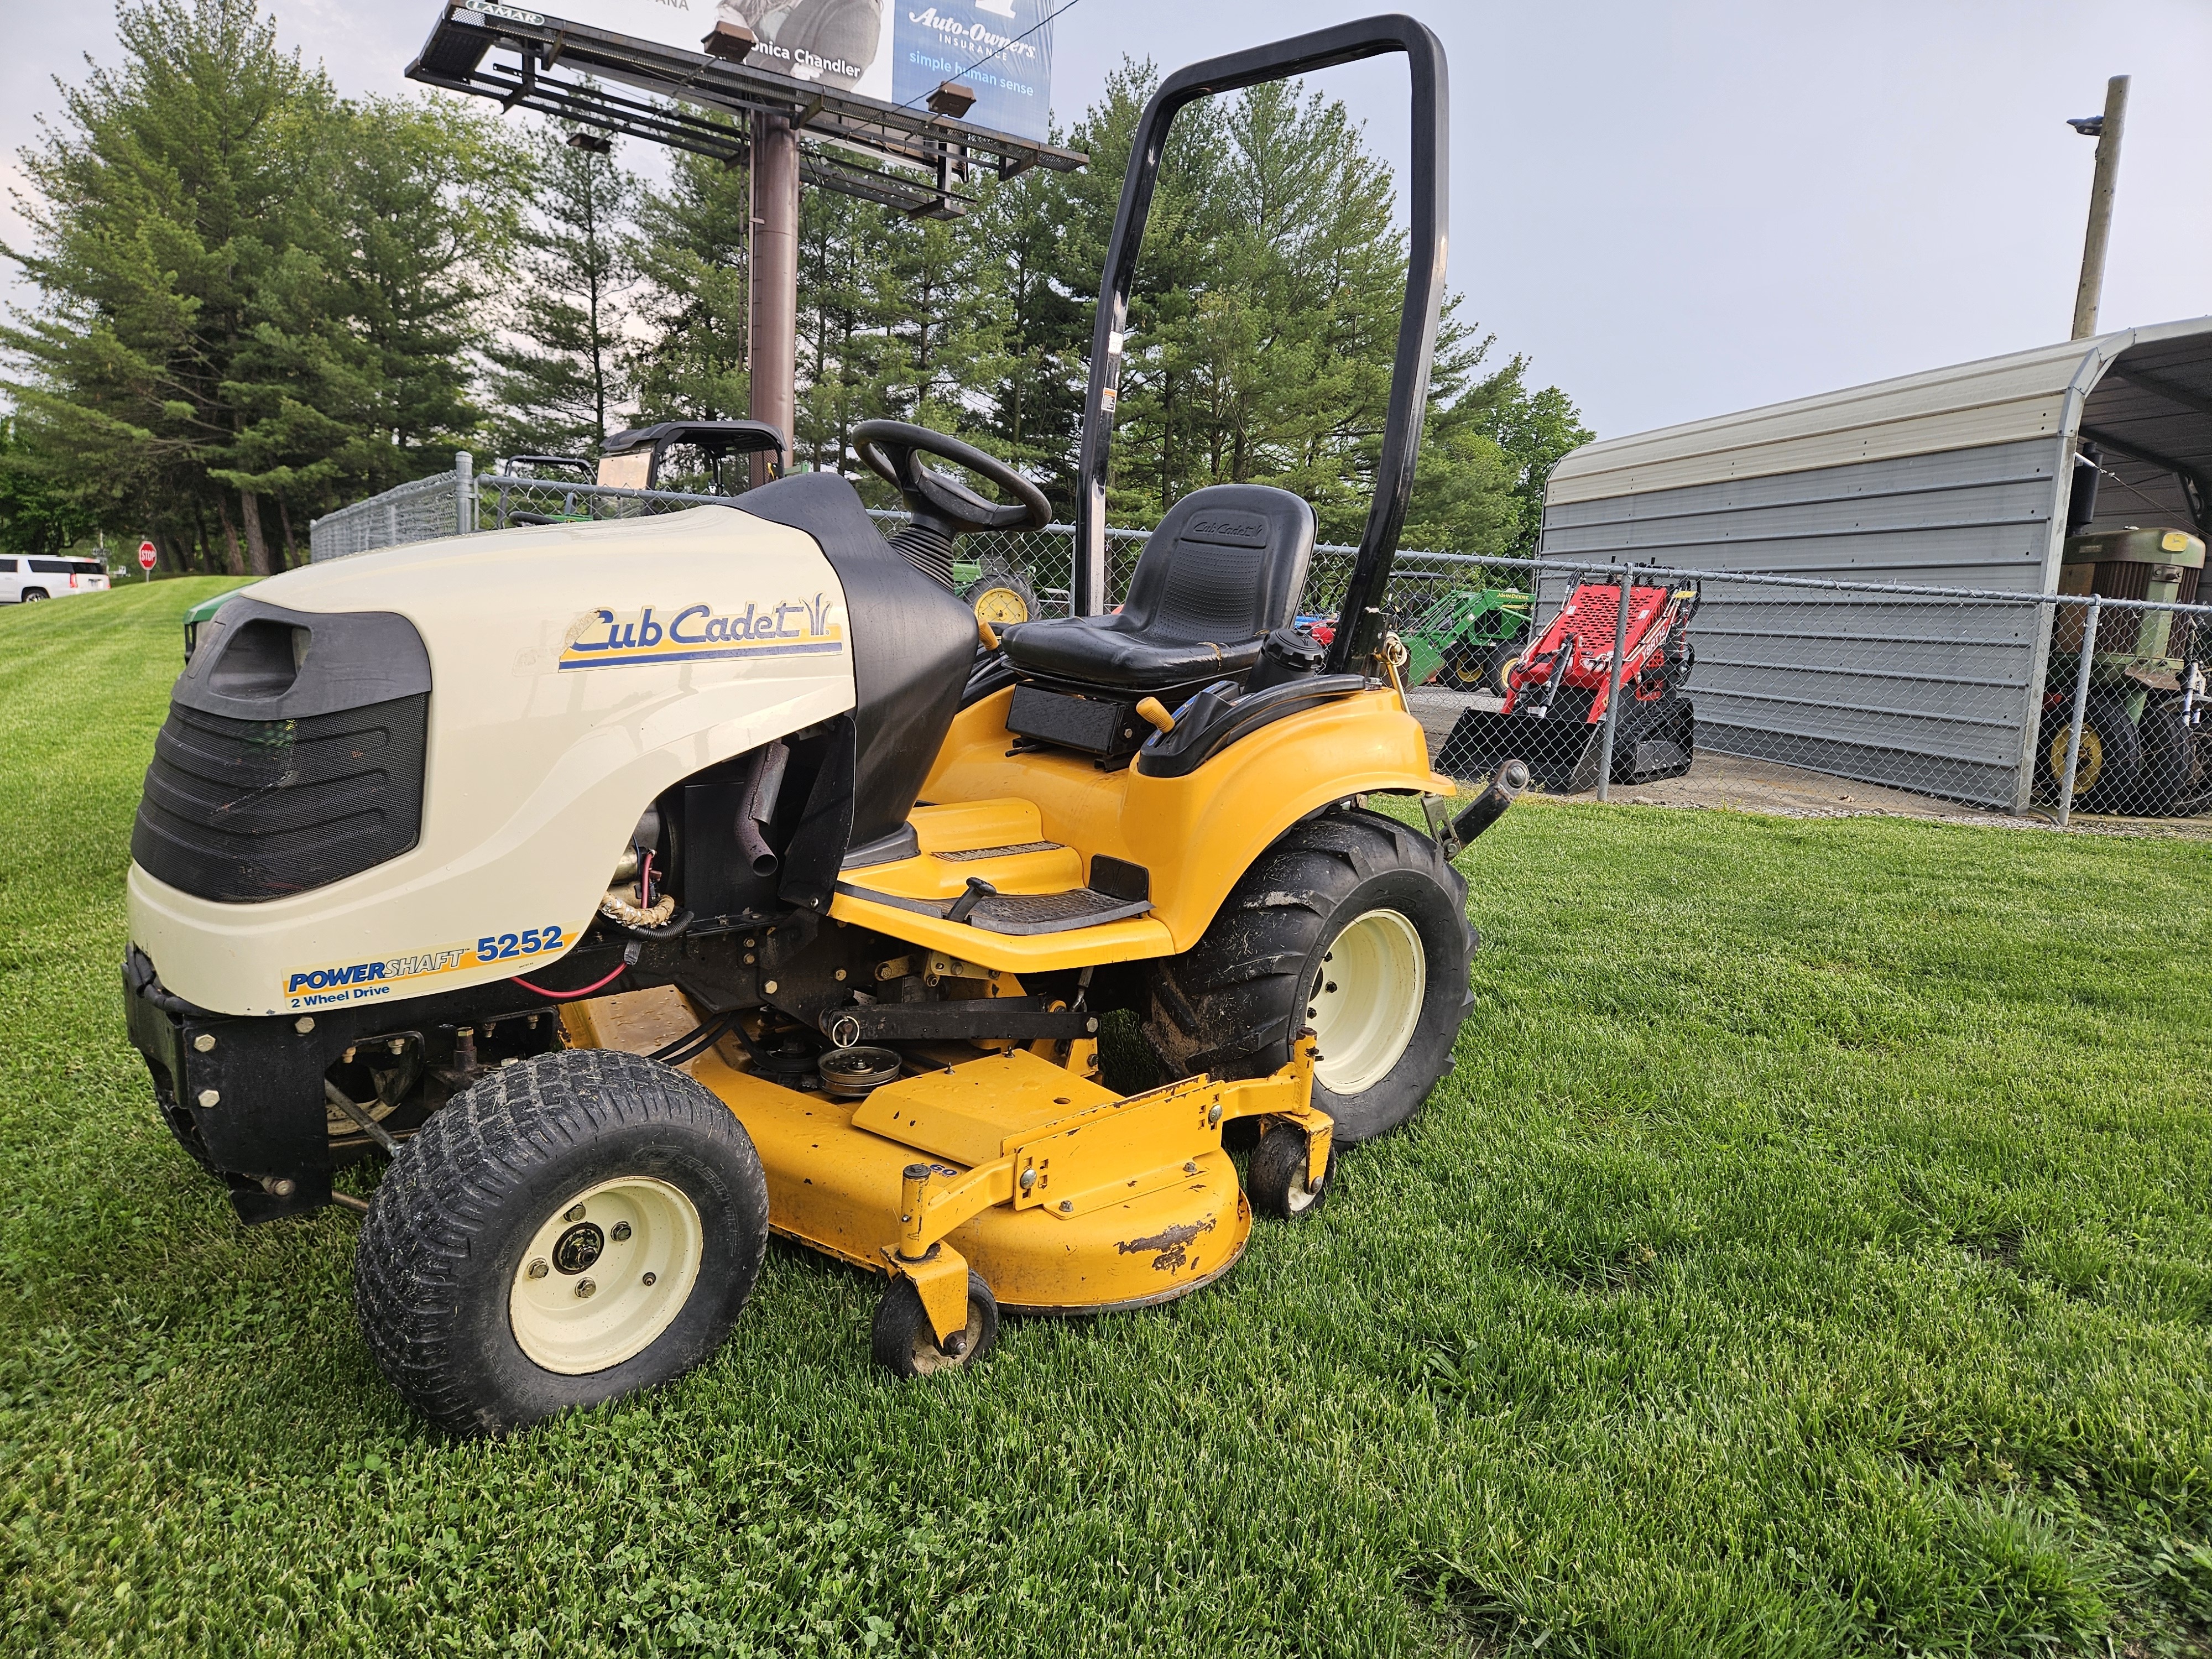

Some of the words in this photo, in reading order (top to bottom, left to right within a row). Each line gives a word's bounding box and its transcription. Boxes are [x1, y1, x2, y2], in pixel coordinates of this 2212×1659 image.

[473, 2, 536, 23] LAMAR
[909, 7, 1035, 58] Auto-Owners
[938, 33, 1008, 61] INSURANCE
[794, 49, 860, 77] Chandler
[910, 51, 952, 72] simple
[955, 62, 997, 86] human
[1000, 79, 1034, 96] sense
[1193, 521, 1217, 534] Cub
[1217, 524, 1254, 538] Cadet
[141, 550, 155, 561] STOP
[570, 608, 662, 650] Cub
[670, 601, 804, 643] Cadet
[476, 926, 564, 962] 5252
[288, 948, 464, 992] POWERSHAFT
[290, 998, 300, 1008] 2
[304, 988, 349, 1005] Wheel
[353, 984, 390, 998] Drive
[930, 1165, 957, 1175] 60
